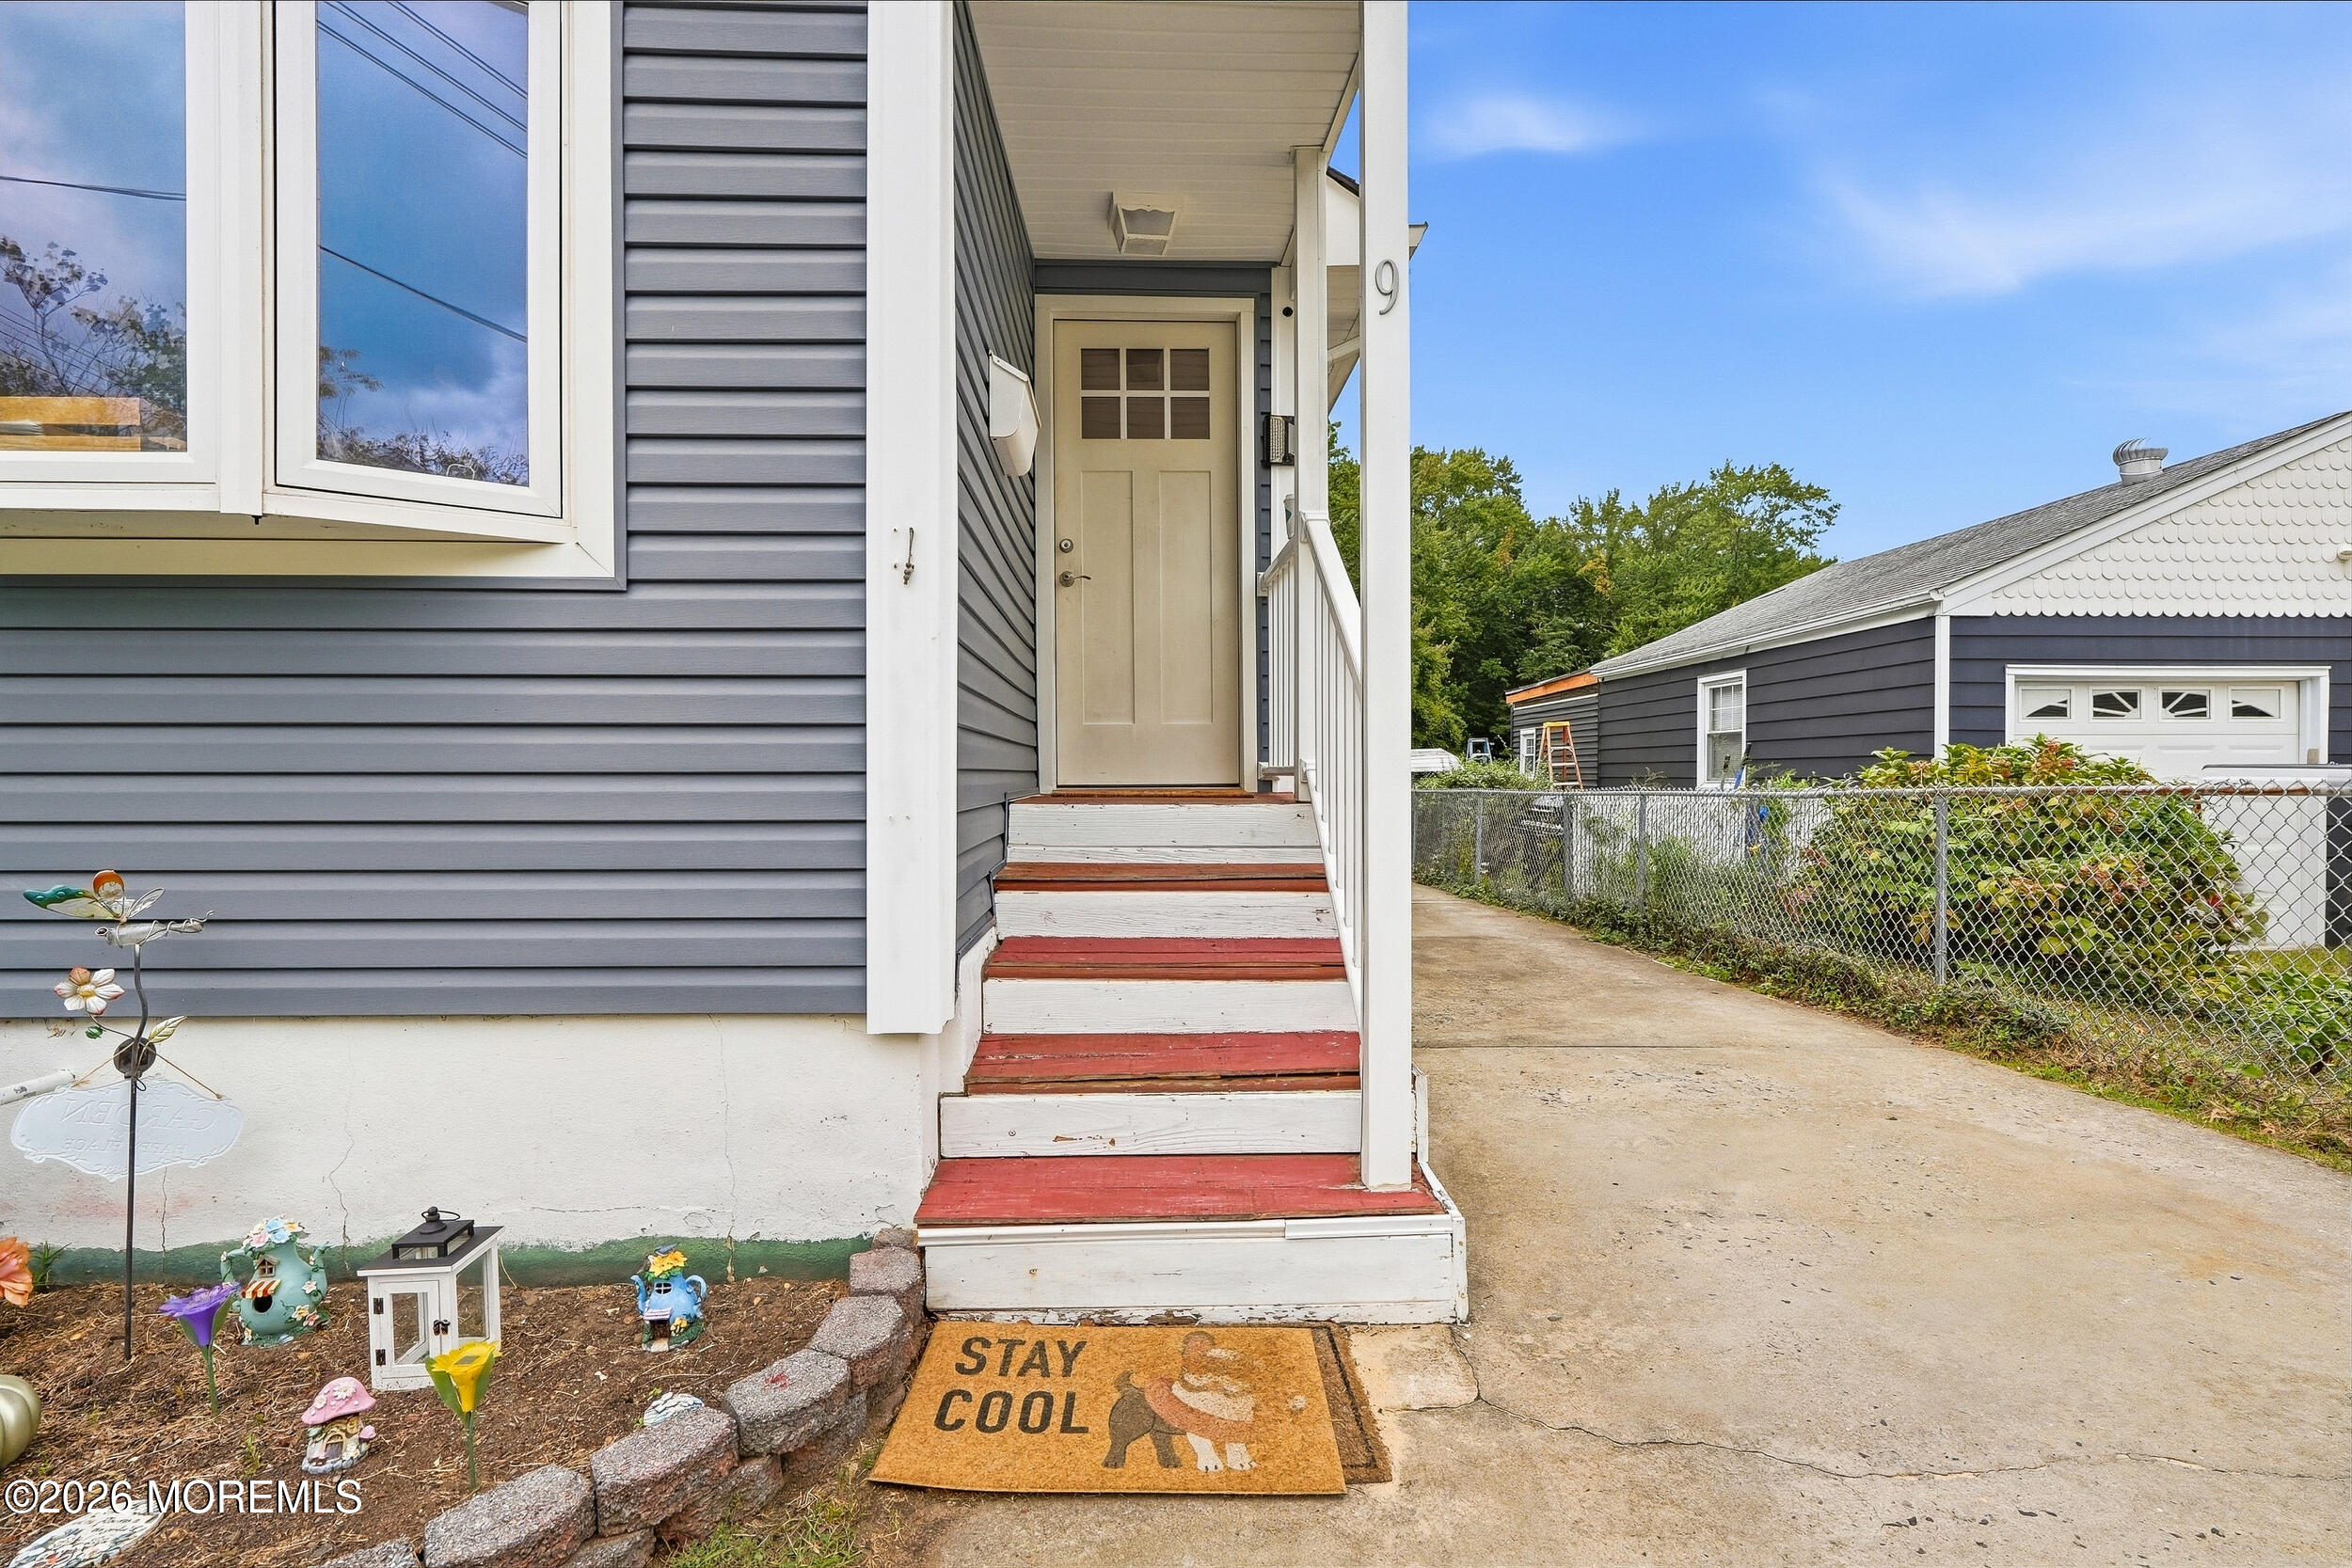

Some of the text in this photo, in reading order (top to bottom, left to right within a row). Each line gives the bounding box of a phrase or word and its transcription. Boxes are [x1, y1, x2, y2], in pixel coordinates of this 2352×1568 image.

[1375, 259, 1400, 316] 9
[954, 1336, 1089, 1379] STAY
[933, 1388, 1089, 1434] COOL
